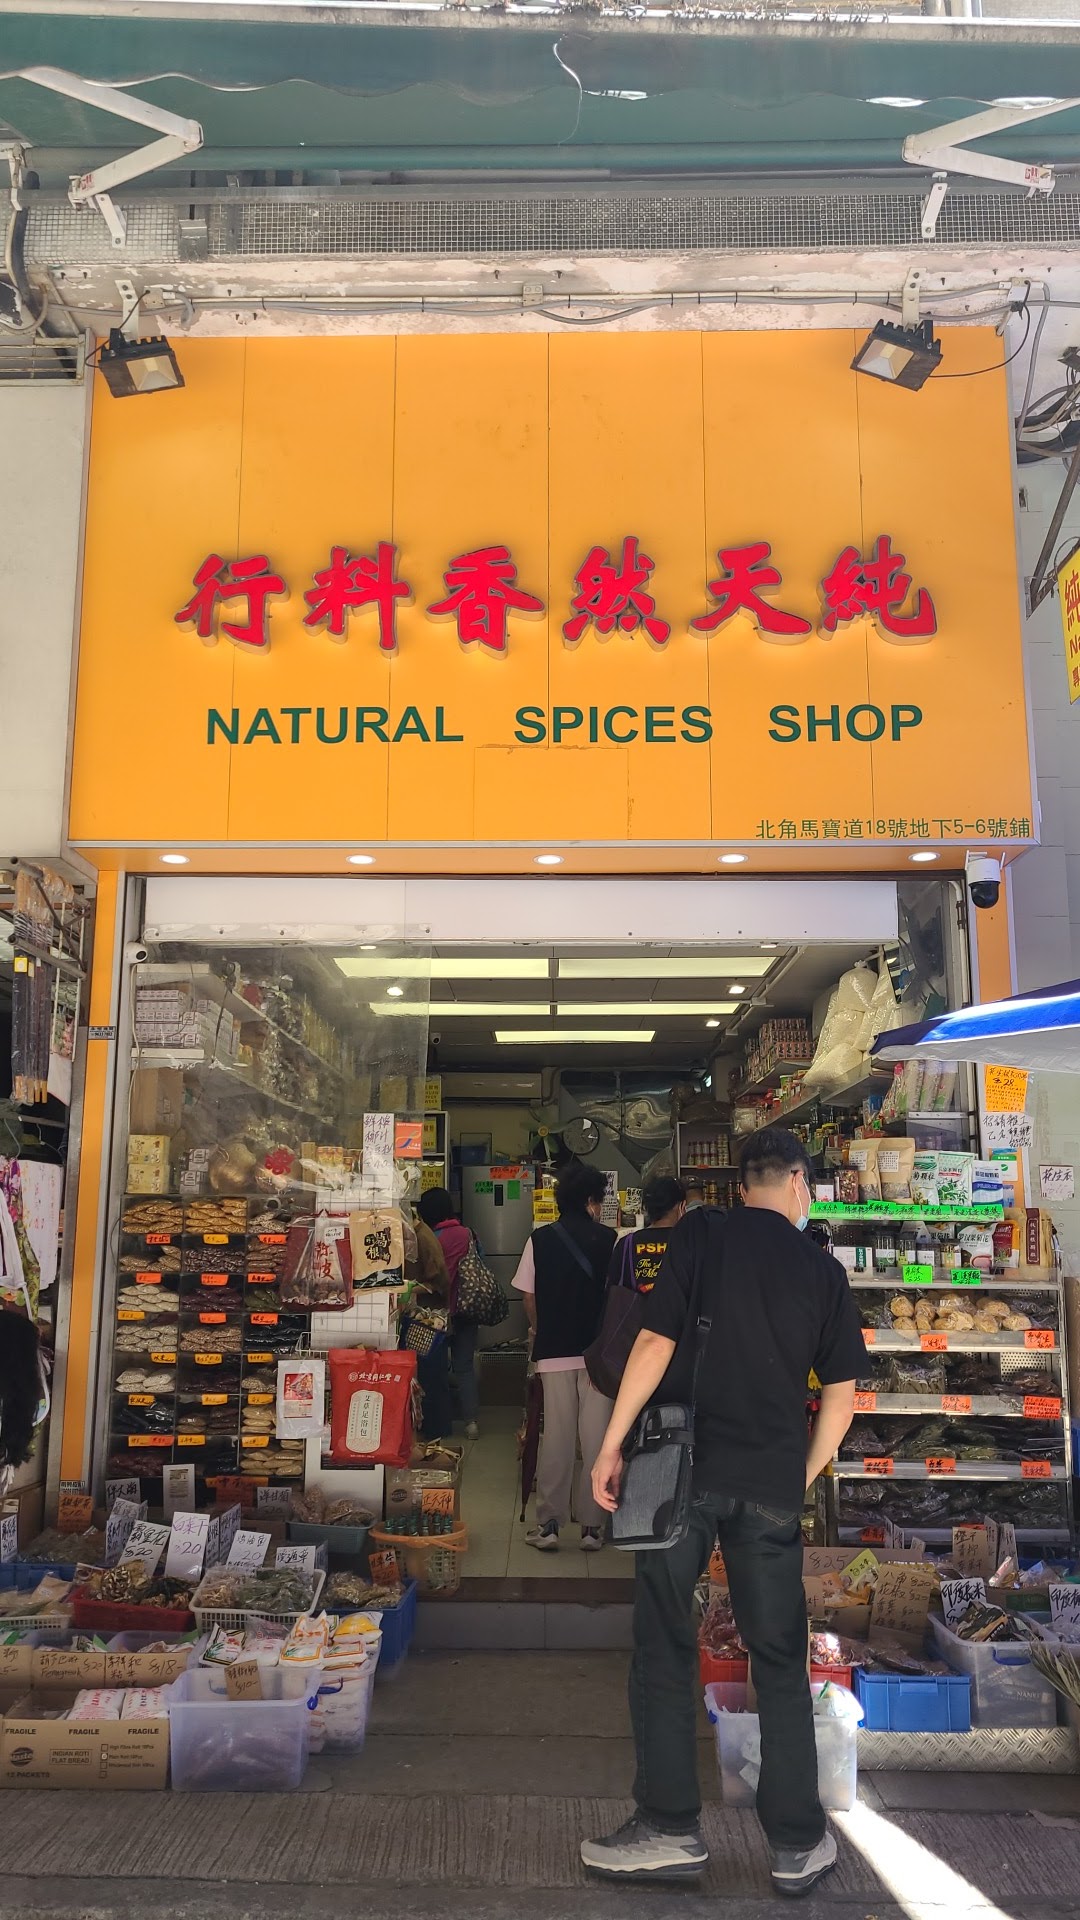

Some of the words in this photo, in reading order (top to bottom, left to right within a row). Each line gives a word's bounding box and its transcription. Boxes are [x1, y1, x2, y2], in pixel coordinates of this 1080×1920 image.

[206, 706, 464, 744] NATURAL
[514, 706, 713, 743] SPICES
[768, 704, 923, 742] SHOP
[756, 817, 1030, 839] 北角馬寶道18號地下5-6號鋪
